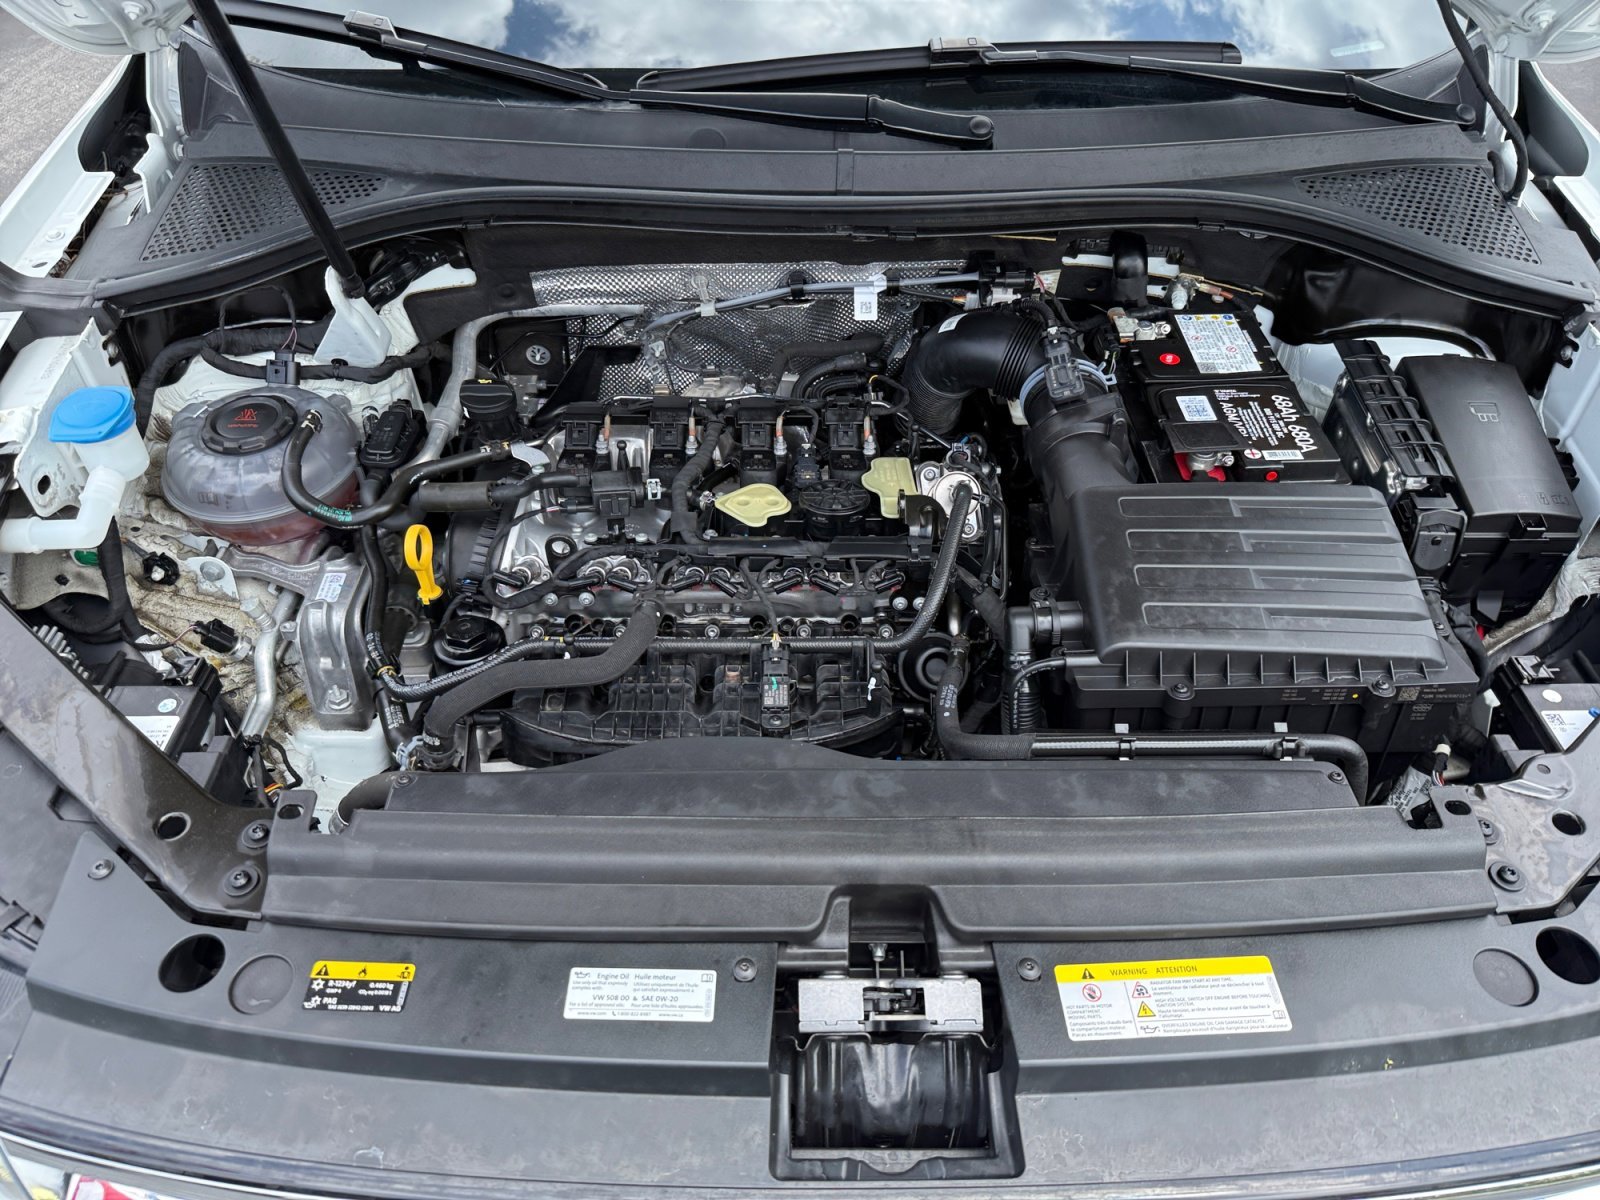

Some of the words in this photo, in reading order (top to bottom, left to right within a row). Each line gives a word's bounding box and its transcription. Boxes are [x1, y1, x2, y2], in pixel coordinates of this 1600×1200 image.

[1271, 394, 1300, 422] 68Ah
[1288, 424, 1318, 453] 680A
[597, 972, 619, 980] Engine
[1110, 967, 1148, 976] WARNING
[1156, 965, 1198, 974] ATTENTION
